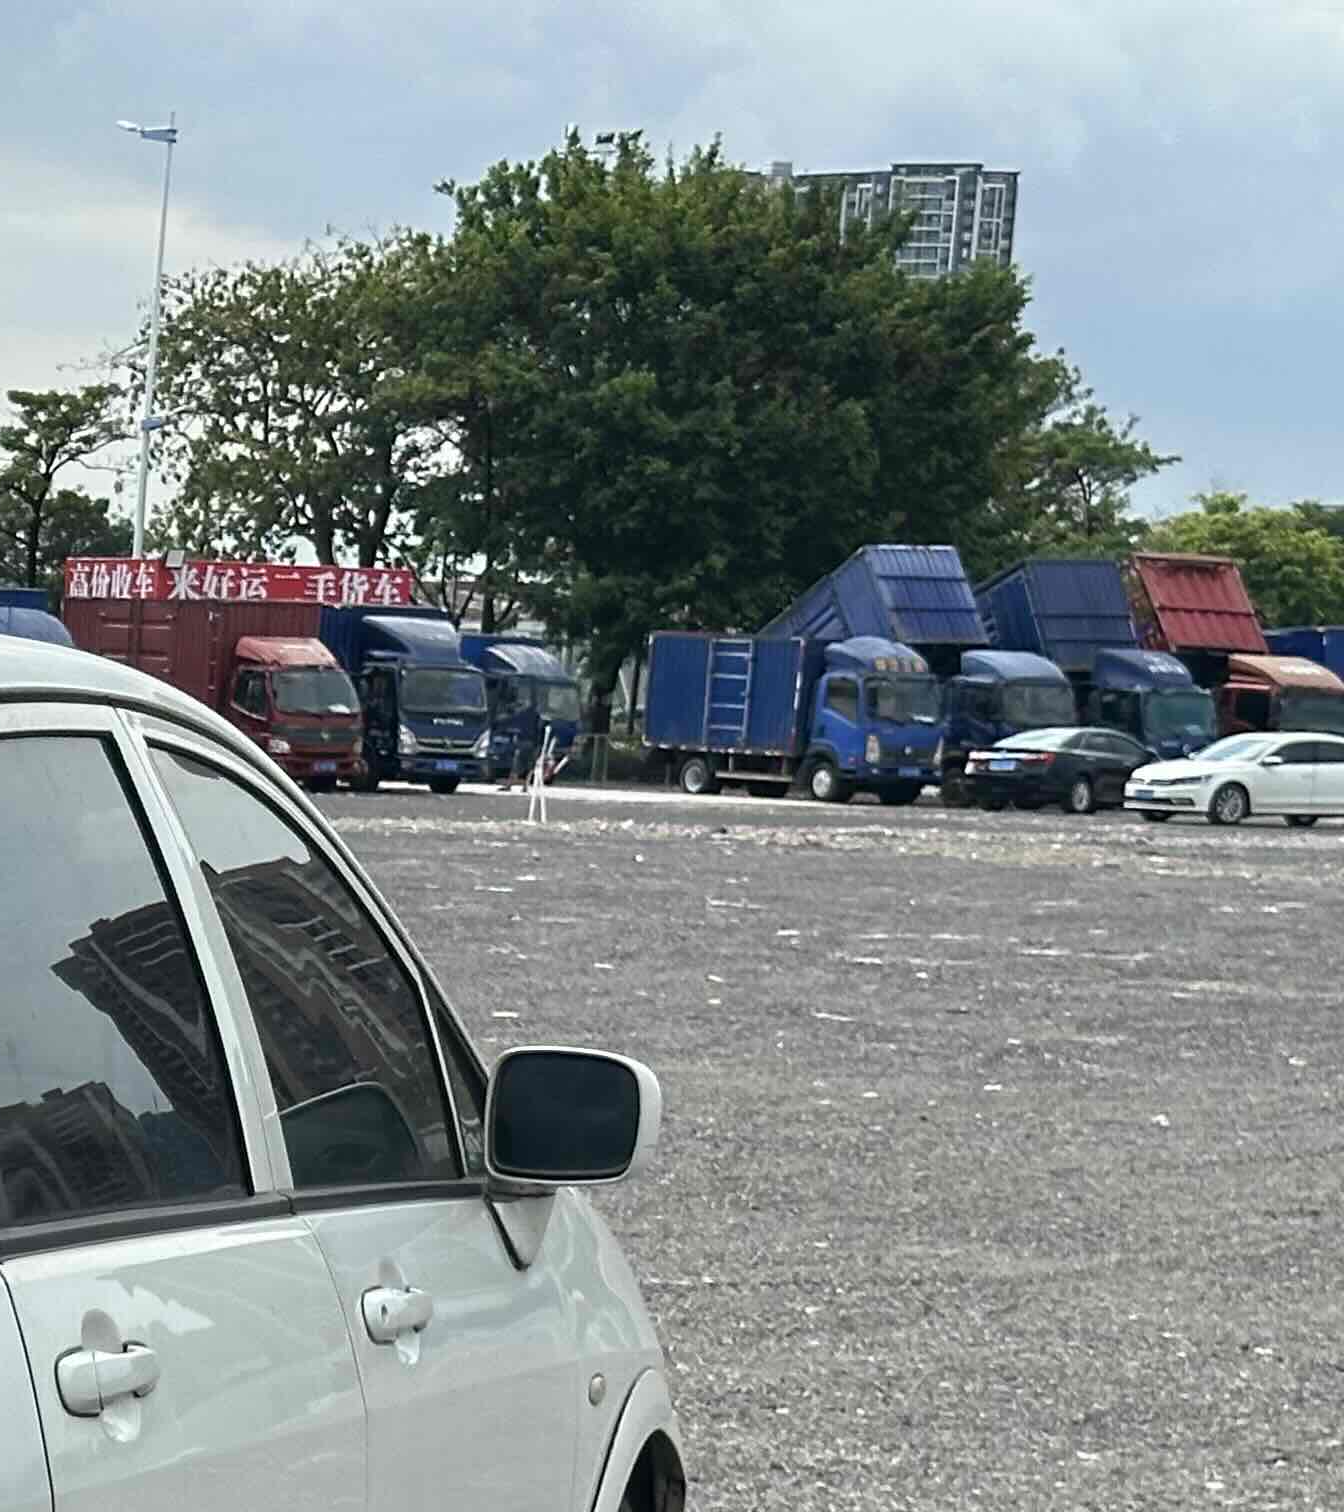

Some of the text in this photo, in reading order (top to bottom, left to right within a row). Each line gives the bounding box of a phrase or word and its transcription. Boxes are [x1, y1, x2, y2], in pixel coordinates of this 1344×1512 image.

[70, 562, 402, 605] 高价收车 来好运二手货车
